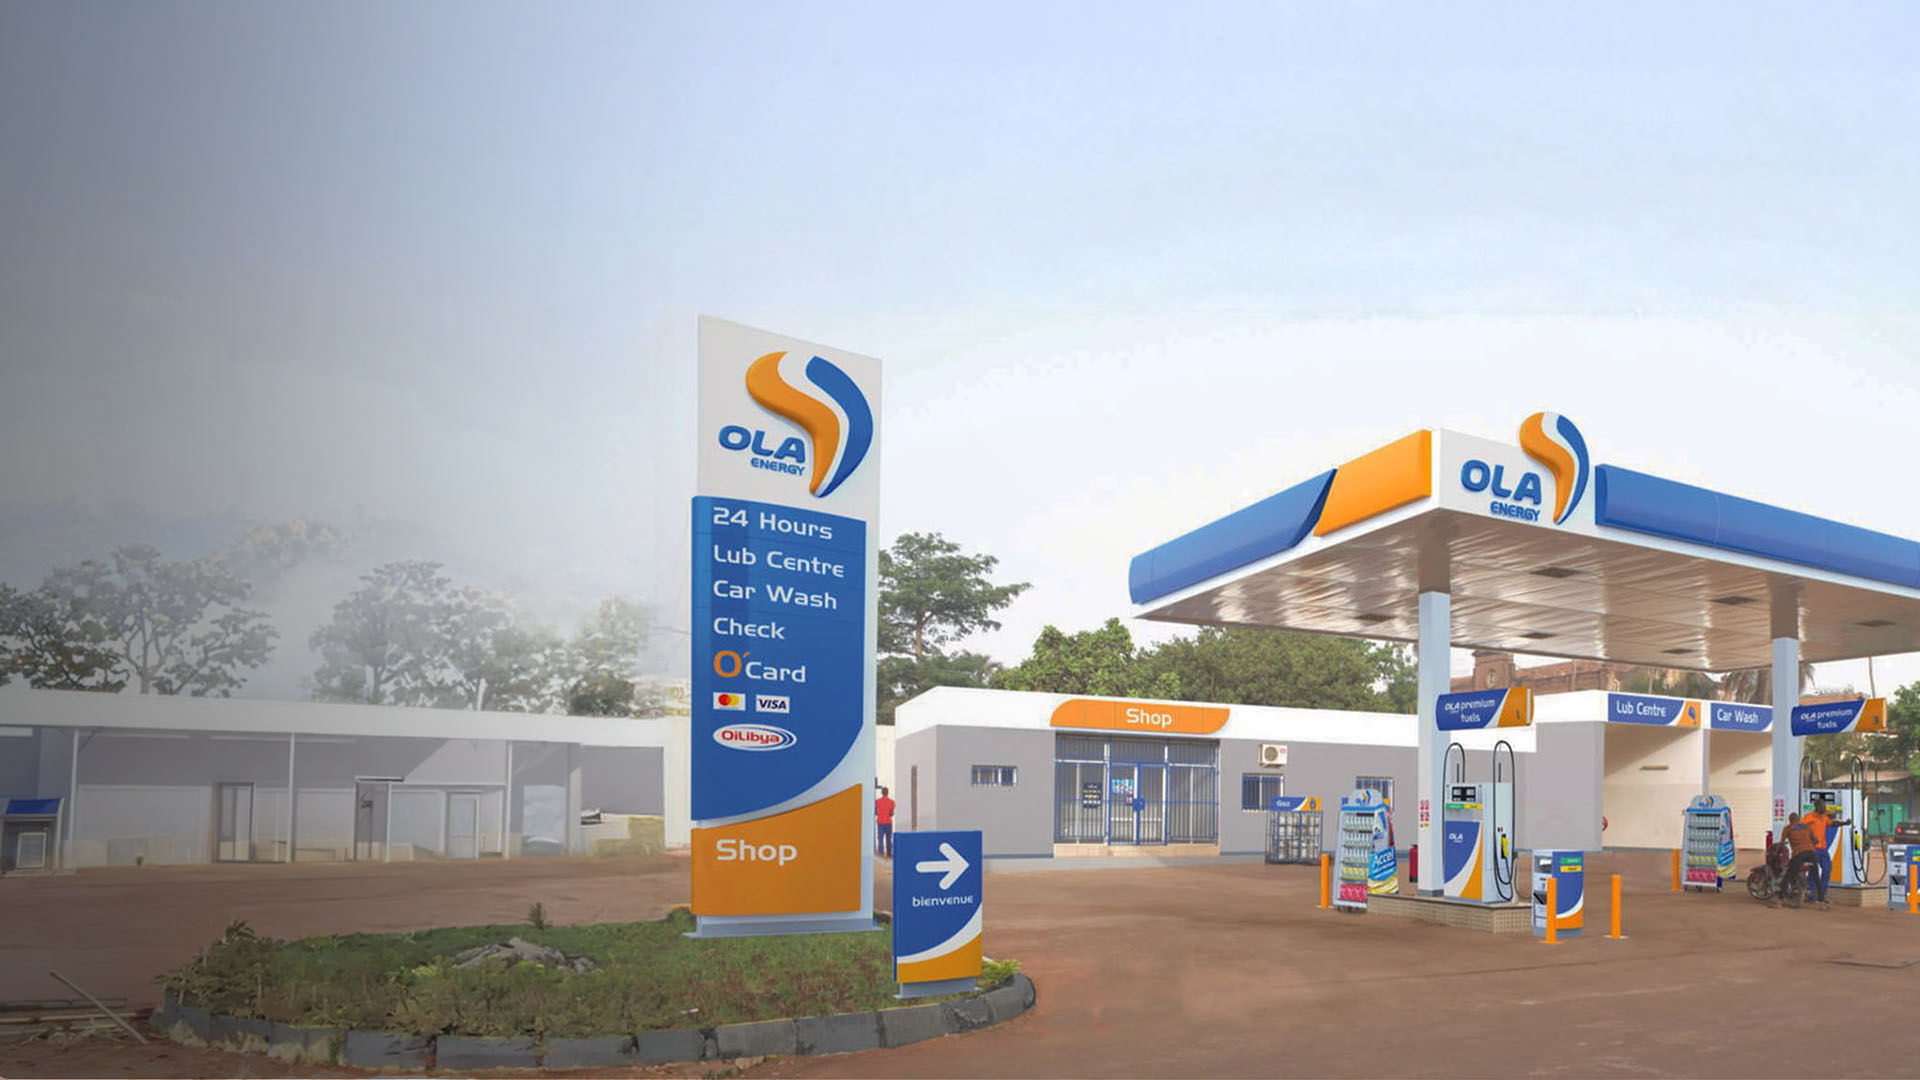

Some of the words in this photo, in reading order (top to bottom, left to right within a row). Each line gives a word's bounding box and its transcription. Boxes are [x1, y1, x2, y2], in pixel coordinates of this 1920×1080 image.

[719, 425, 806, 463] OLA
[751, 457, 805, 476] ENERGY
[1460, 459, 1542, 505] OLA
[1490, 501, 1540, 522] ENERGY
[713, 507, 748, 527] 24
[760, 512, 833, 540] Hours
[714, 545, 756, 565] Lub
[767, 551, 844, 578] Centre
[714, 580, 756, 600] Car
[766, 584, 837, 610] Wash
[714, 617, 785, 640] Check
[759, 698, 787, 710] VISA
[1461, 699, 1496, 711] premium
[1616, 701, 1634, 715] Lub
[1636, 702, 1666, 717] Centre
[1125, 708, 1173, 729] Shop
[1461, 713, 1480, 723] fuels
[1717, 708, 1733, 722] Car
[1735, 709, 1758, 724] Wash
[1817, 708, 1852, 720] premium
[1817, 720, 1837, 729] fuels
[721, 729, 780, 745] OiLibya
[716, 838, 798, 866] Shop
[912, 895, 974, 908] bienvenue
